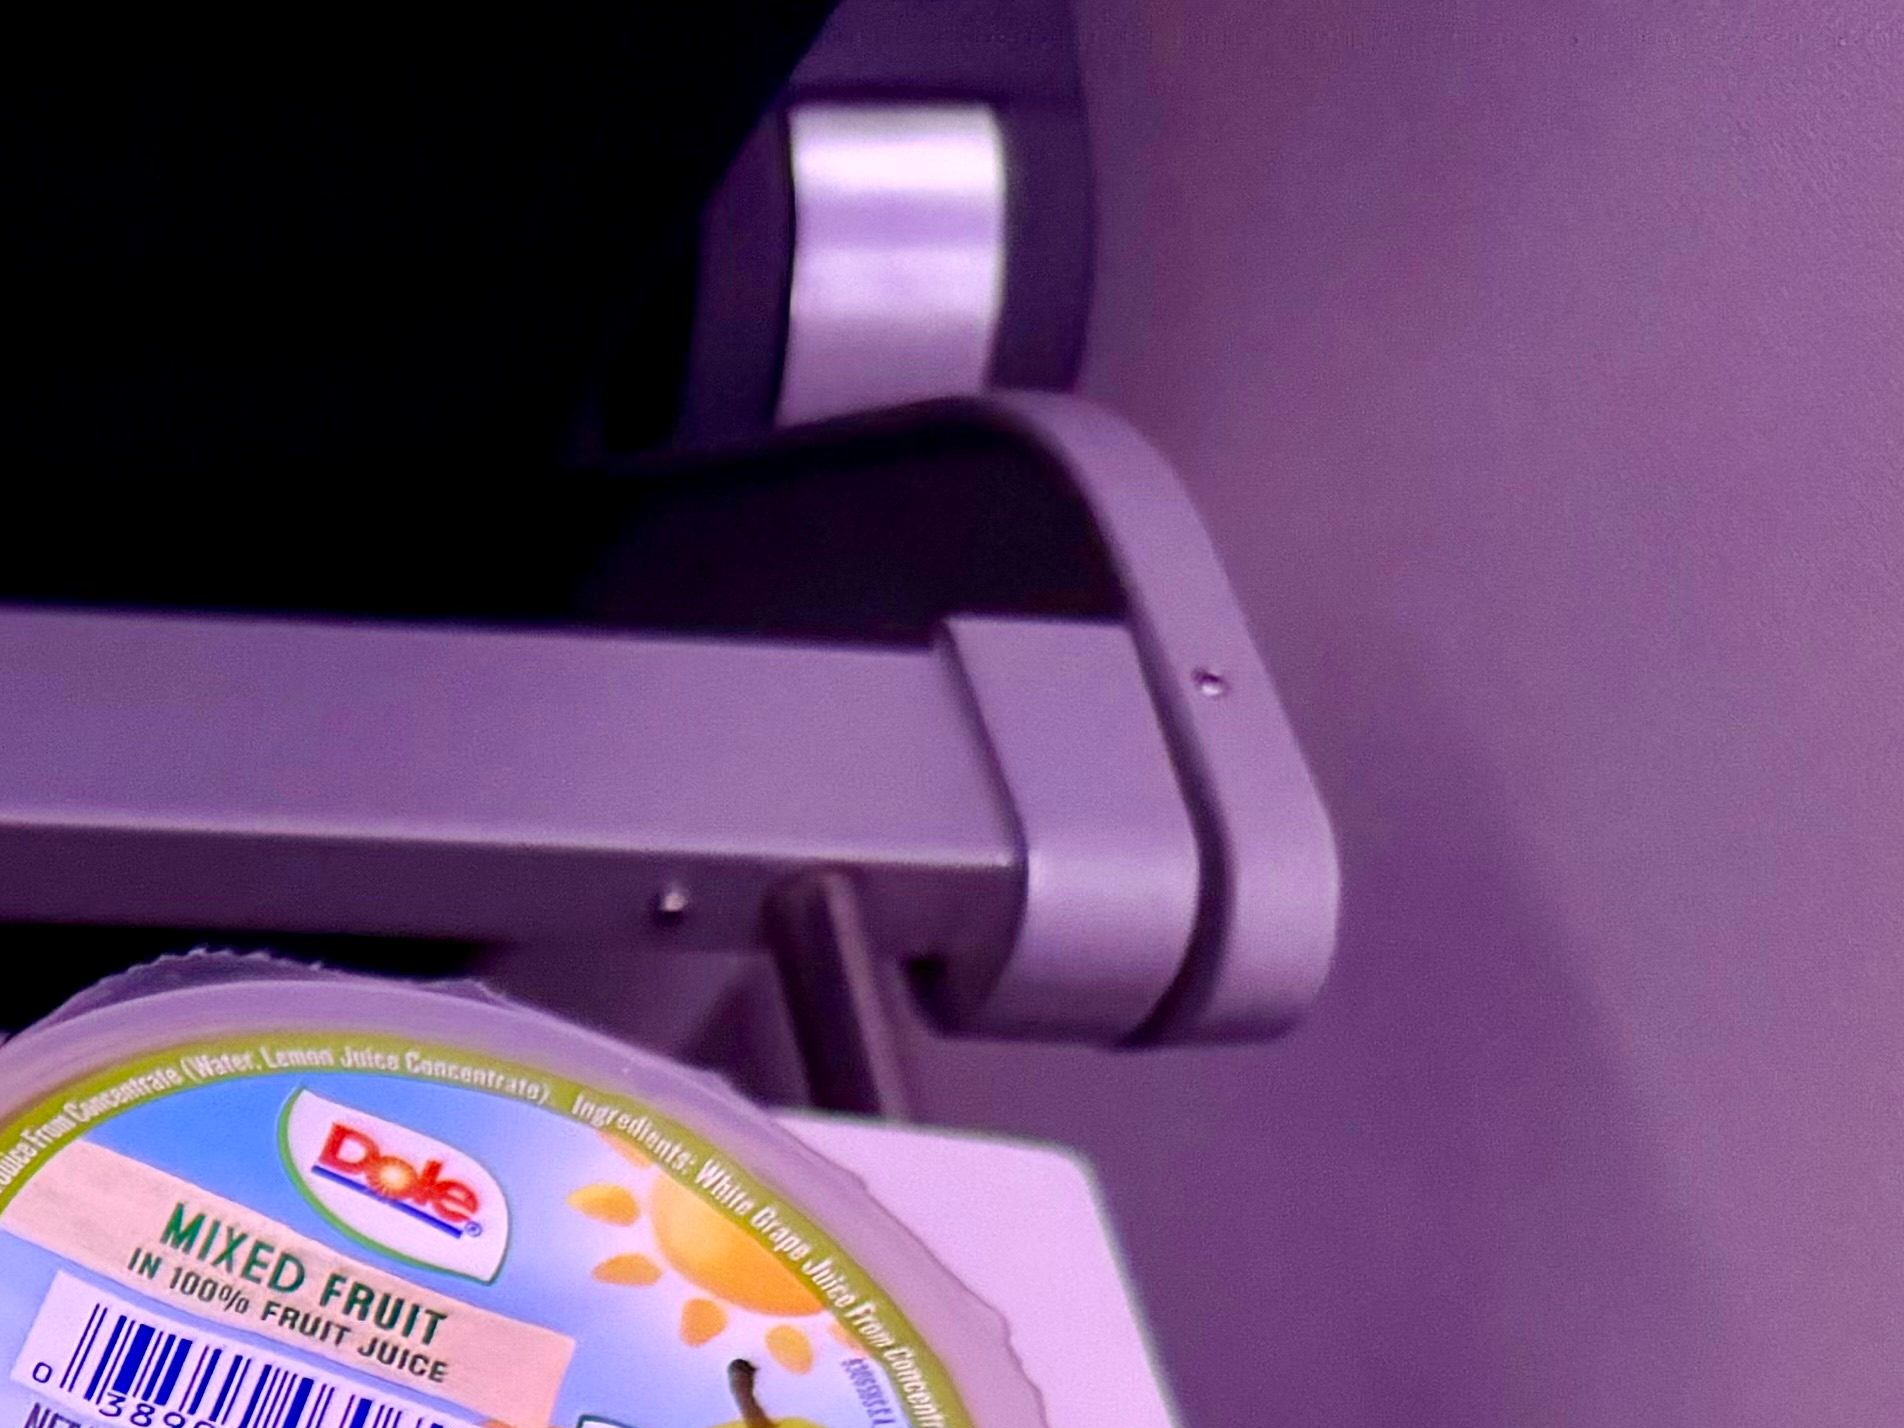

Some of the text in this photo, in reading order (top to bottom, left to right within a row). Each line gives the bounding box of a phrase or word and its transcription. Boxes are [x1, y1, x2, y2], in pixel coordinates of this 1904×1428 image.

[259, 1047, 334, 1068] Lemon
[339, 1045, 400, 1072] Juice
[63, 1066, 183, 1122] Concentrate
[20, 1112, 77, 1149] From
[567, 1095, 694, 1172] Ingredients:
[319, 1122, 480, 1222] Dole
[695, 1158, 754, 1214] White
[750, 1205, 812, 1260] Grape
[160, 1203, 449, 1347] MIXED FRUIT
[801, 1257, 857, 1308] Juice
[128, 1247, 449, 1384] IN 100% FRUIT JUICE
[844, 1300, 895, 1348] From
[32, 1362, 53, 1384] 0
